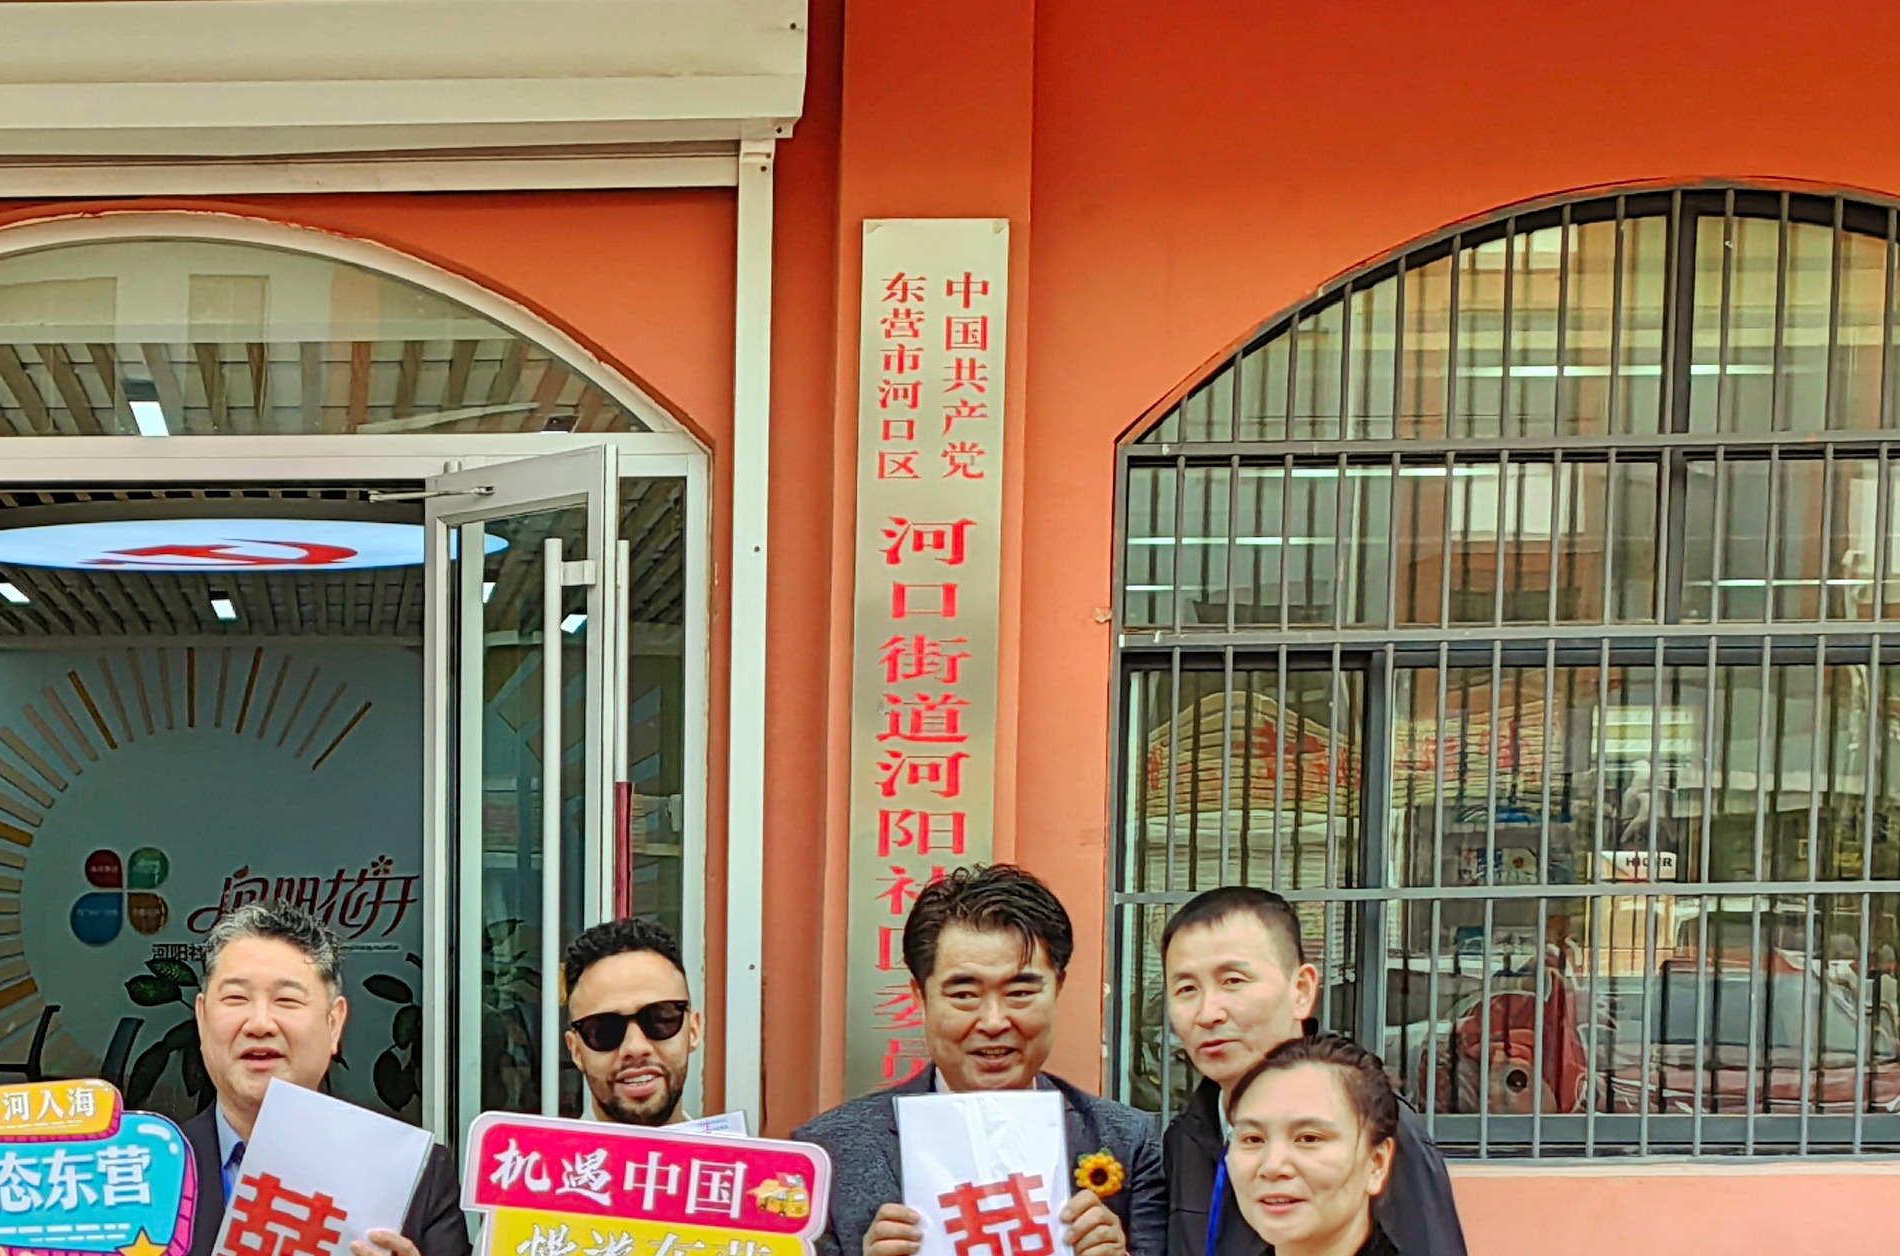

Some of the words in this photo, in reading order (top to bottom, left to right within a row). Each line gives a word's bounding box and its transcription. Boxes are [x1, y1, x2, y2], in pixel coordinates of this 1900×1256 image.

[877, 272, 927, 480] 东营市河口区
[941, 272, 990, 480] 中国共产党
[489, 1138, 748, 1220] 机遇中国
